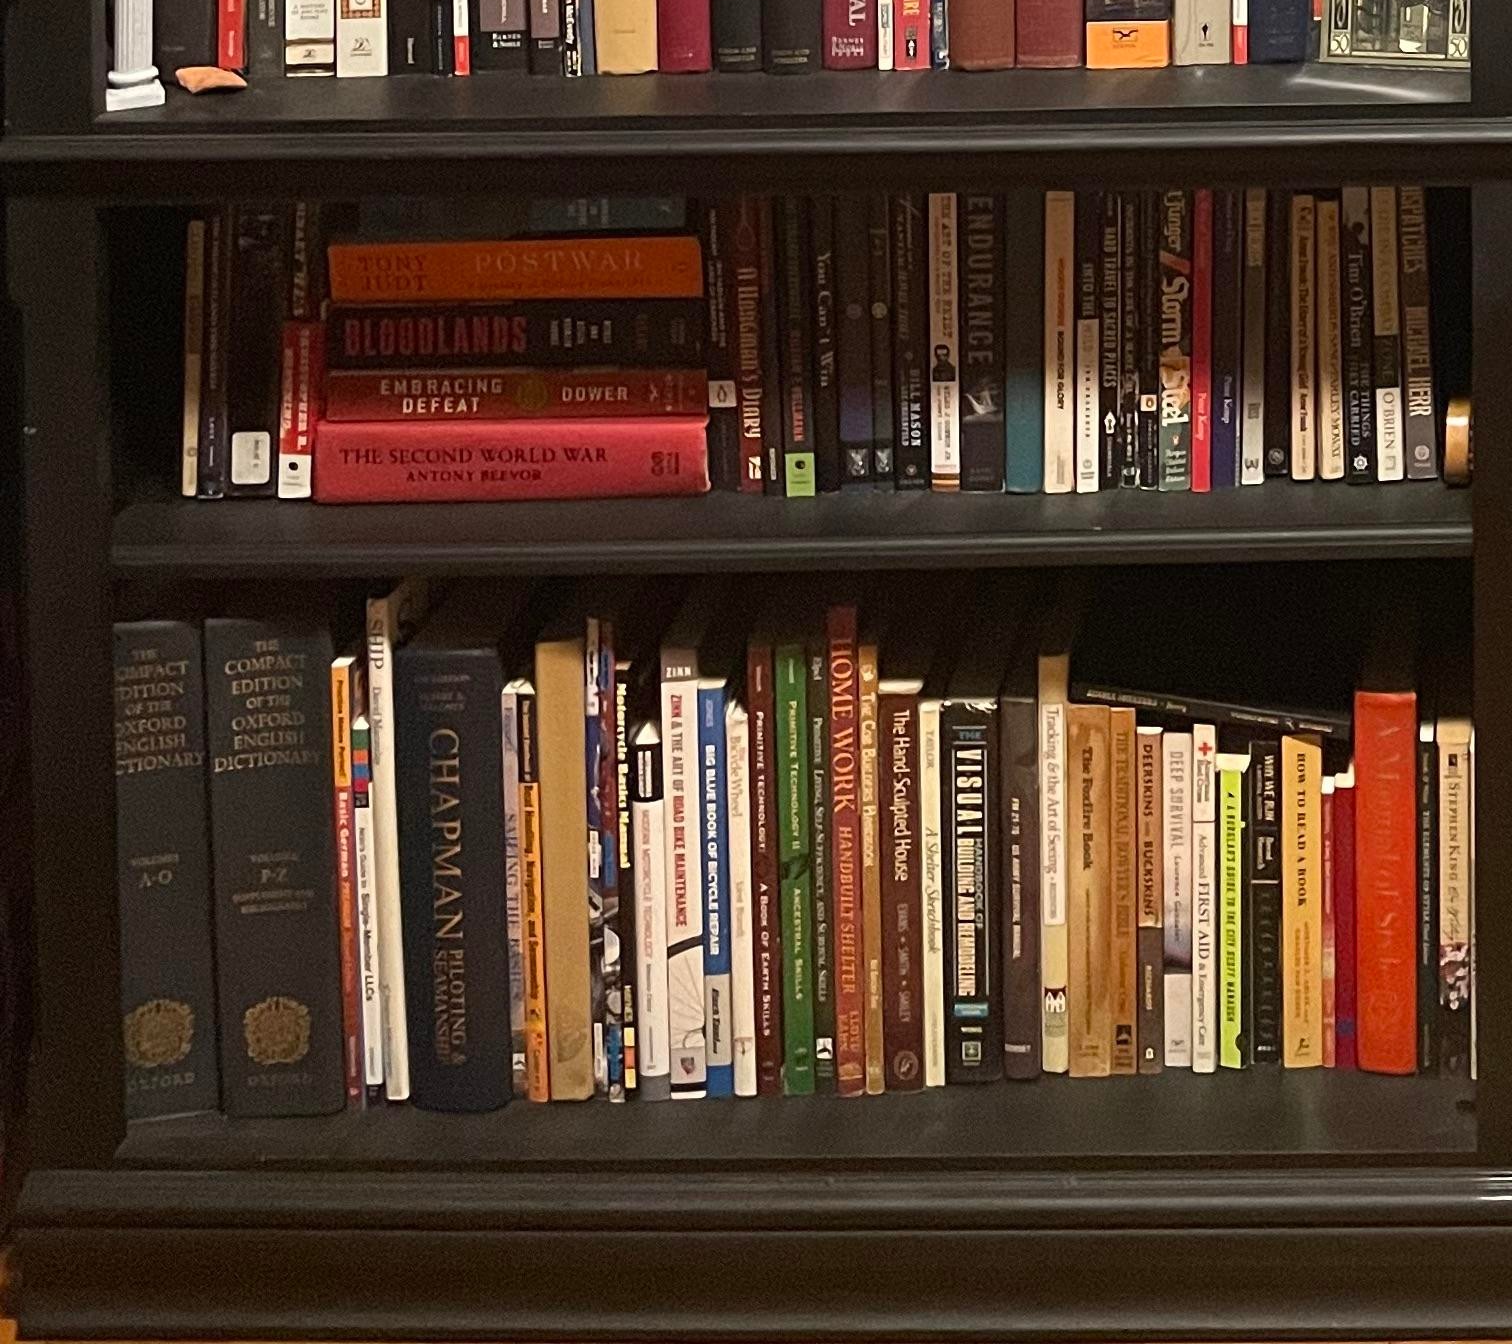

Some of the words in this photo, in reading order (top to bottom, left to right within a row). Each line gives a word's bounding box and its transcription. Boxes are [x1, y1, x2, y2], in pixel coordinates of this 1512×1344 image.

[380, 378, 502, 395] EMBRACING
[402, 398, 480, 413] DEFEAT
[562, 387, 629, 400] DOWER
[1162, 368, 1187, 426] Steel
[340, 449, 382, 464] THE
[390, 449, 472, 464] SECOND
[481, 449, 556, 462] WORLD
[564, 448, 607, 462] WAR
[830, 639, 854, 720] HOME
[892, 710, 910, 734] The
[834, 728, 856, 812] WORK
[891, 737, 912, 837] Hand-Sculpted
[956, 749, 982, 835] VISUAL
[428, 728, 464, 939] CHAPMAN
[838, 826, 855, 919] HANDBUILT
[893, 840, 911, 881] House
[1197, 882, 1210, 926] FIRST
[841, 923, 857, 993] SHELTER
[1198, 930, 1211, 960] AID
